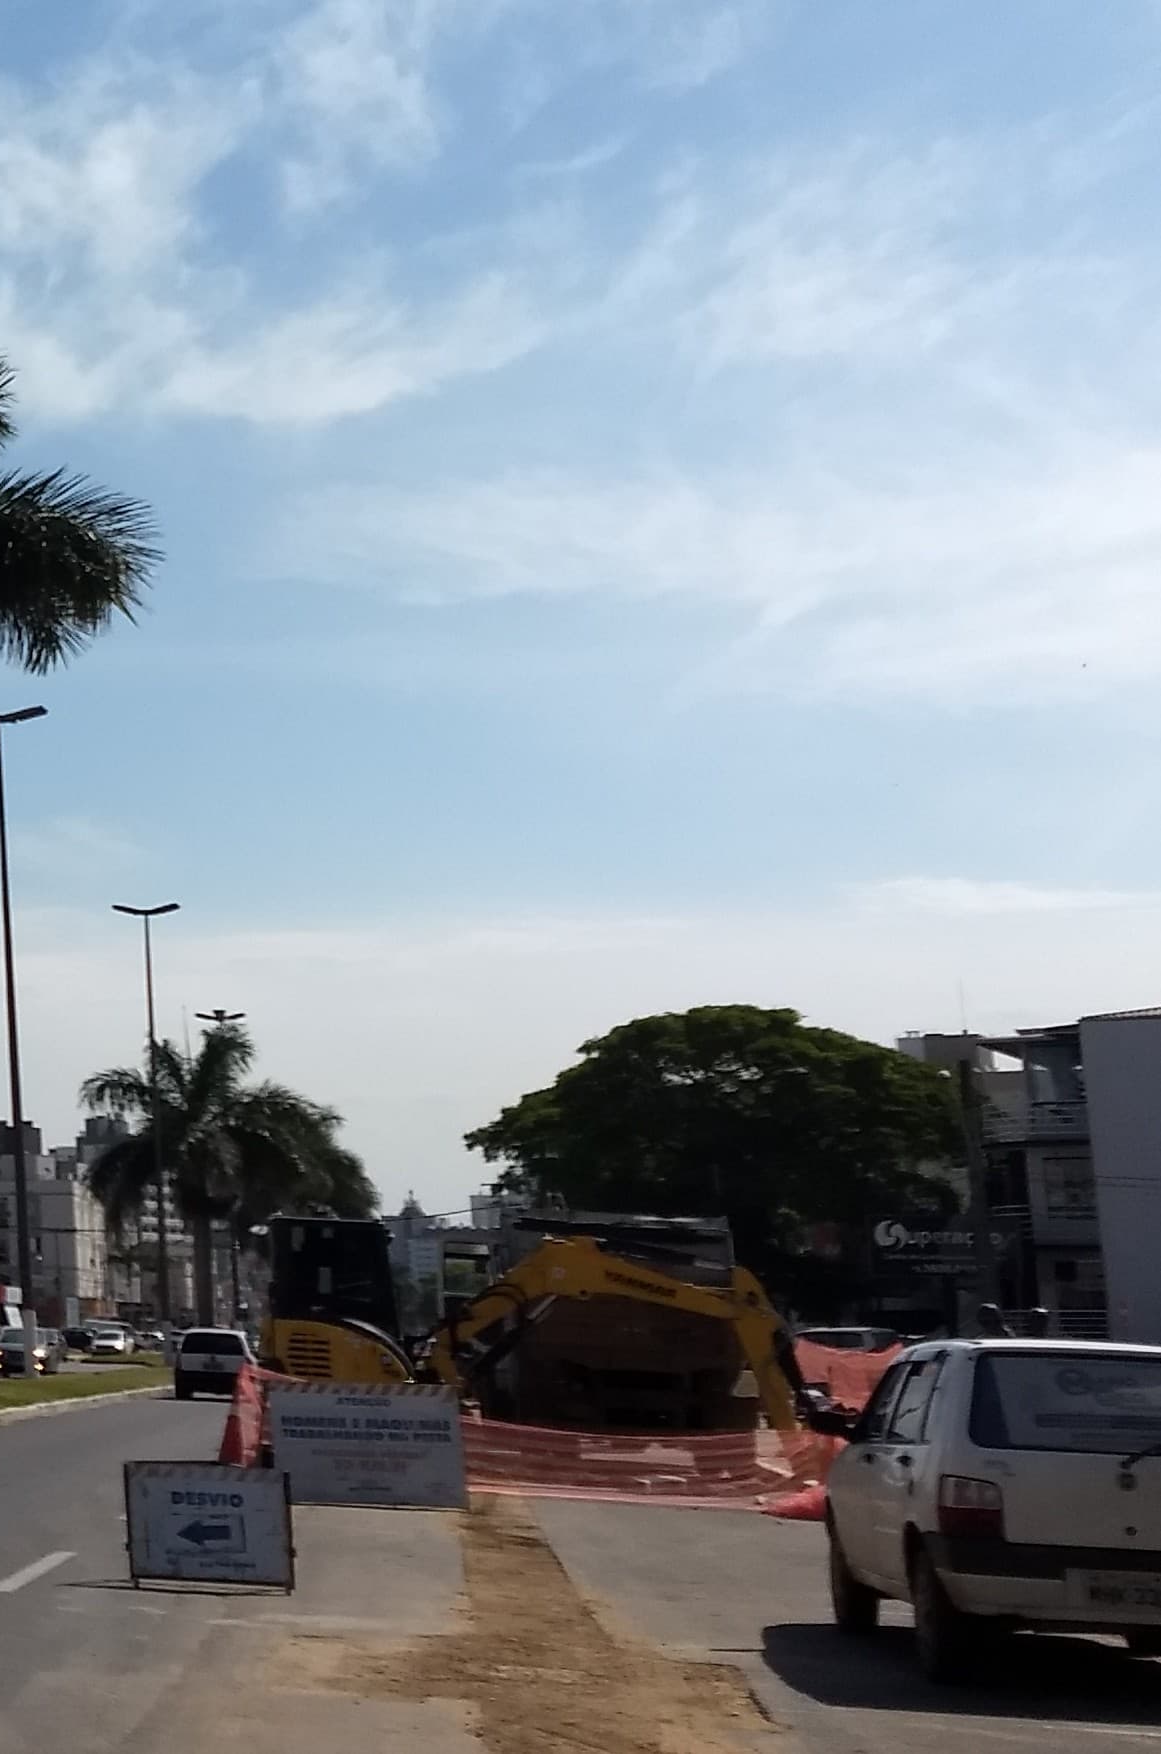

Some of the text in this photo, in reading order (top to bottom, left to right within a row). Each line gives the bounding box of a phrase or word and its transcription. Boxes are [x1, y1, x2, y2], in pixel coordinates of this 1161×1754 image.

[281, 1415, 347, 1429] HOMENS
[282, 1428, 385, 1441] TRABALHANDO
[413, 1432, 452, 1443] PISTA
[170, 1490, 245, 1509] DESVIO
